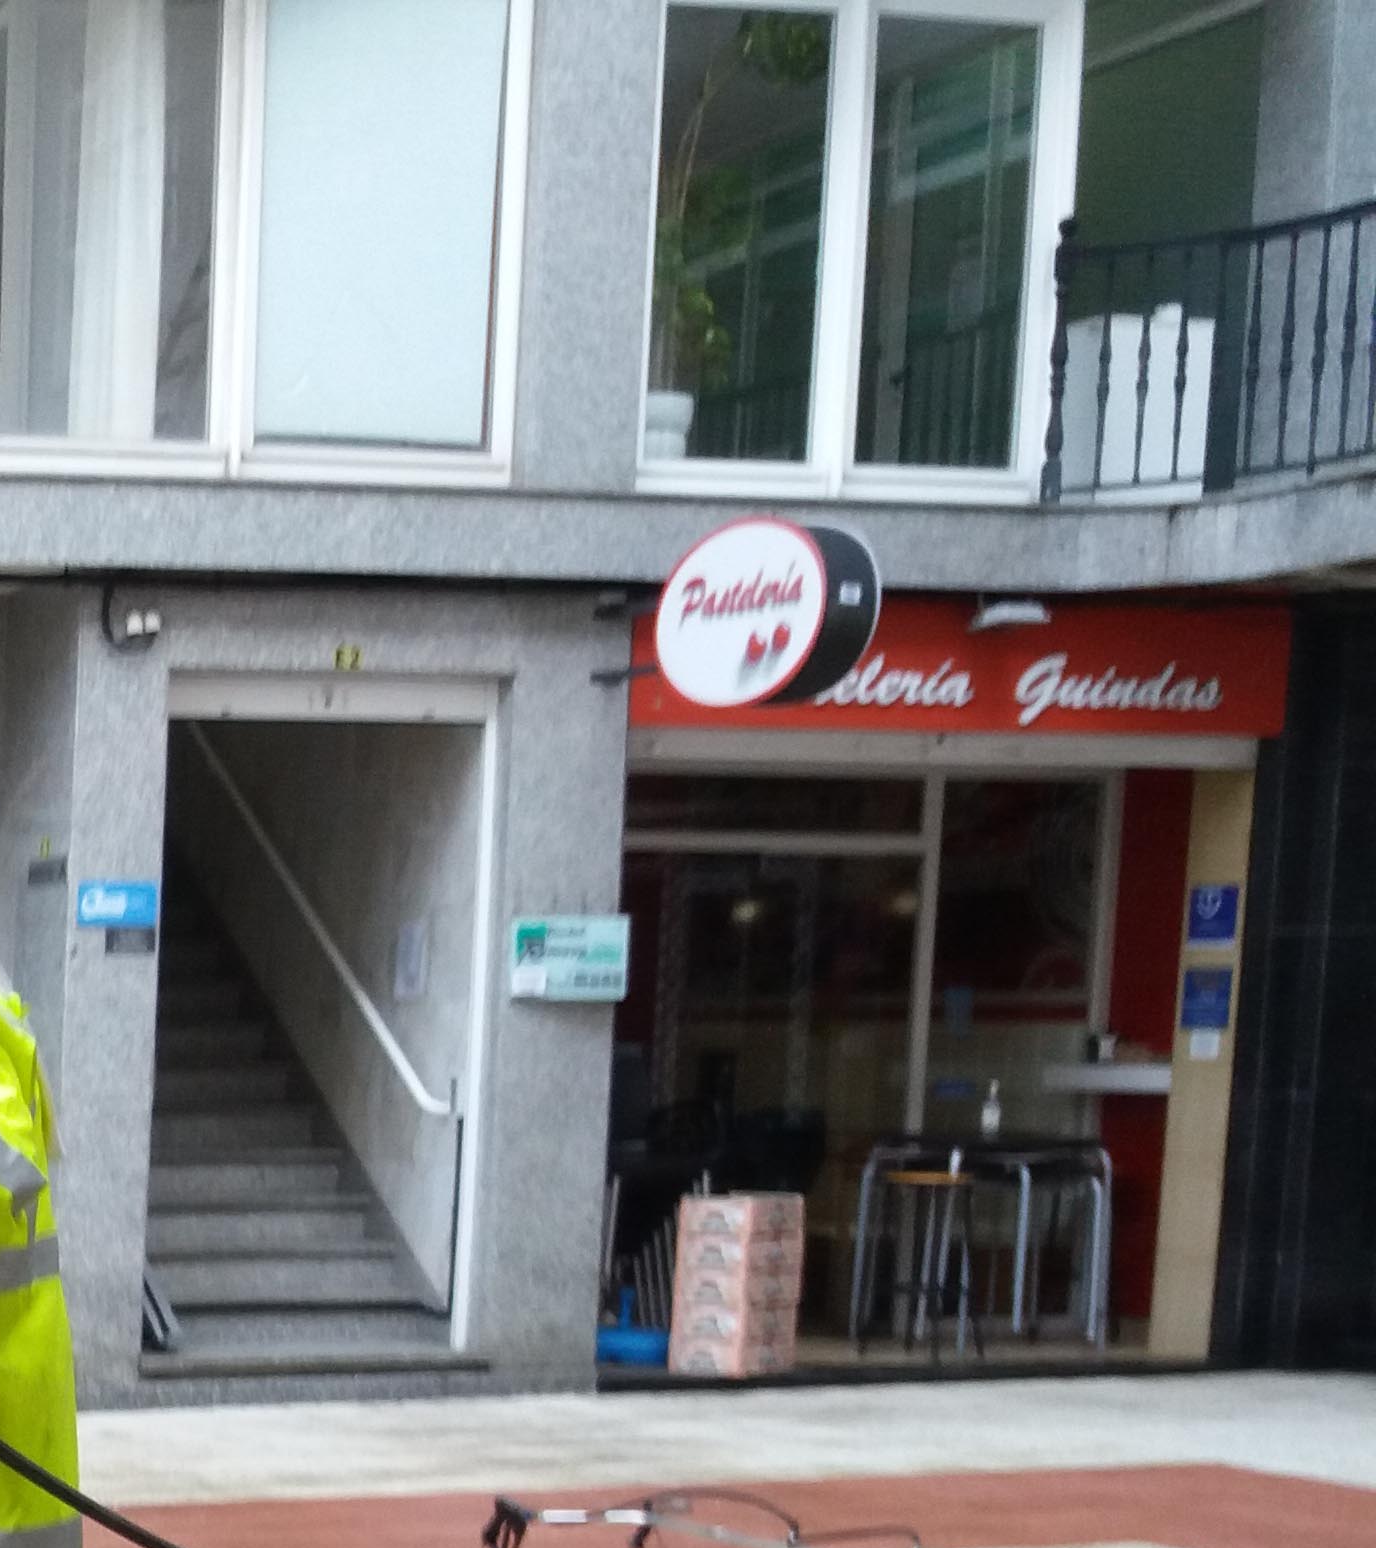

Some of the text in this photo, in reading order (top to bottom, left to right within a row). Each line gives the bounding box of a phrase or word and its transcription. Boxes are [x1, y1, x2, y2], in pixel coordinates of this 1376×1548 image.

[679, 561, 804, 628] Pastelería
[815, 652, 1223, 727] elería Guindas
